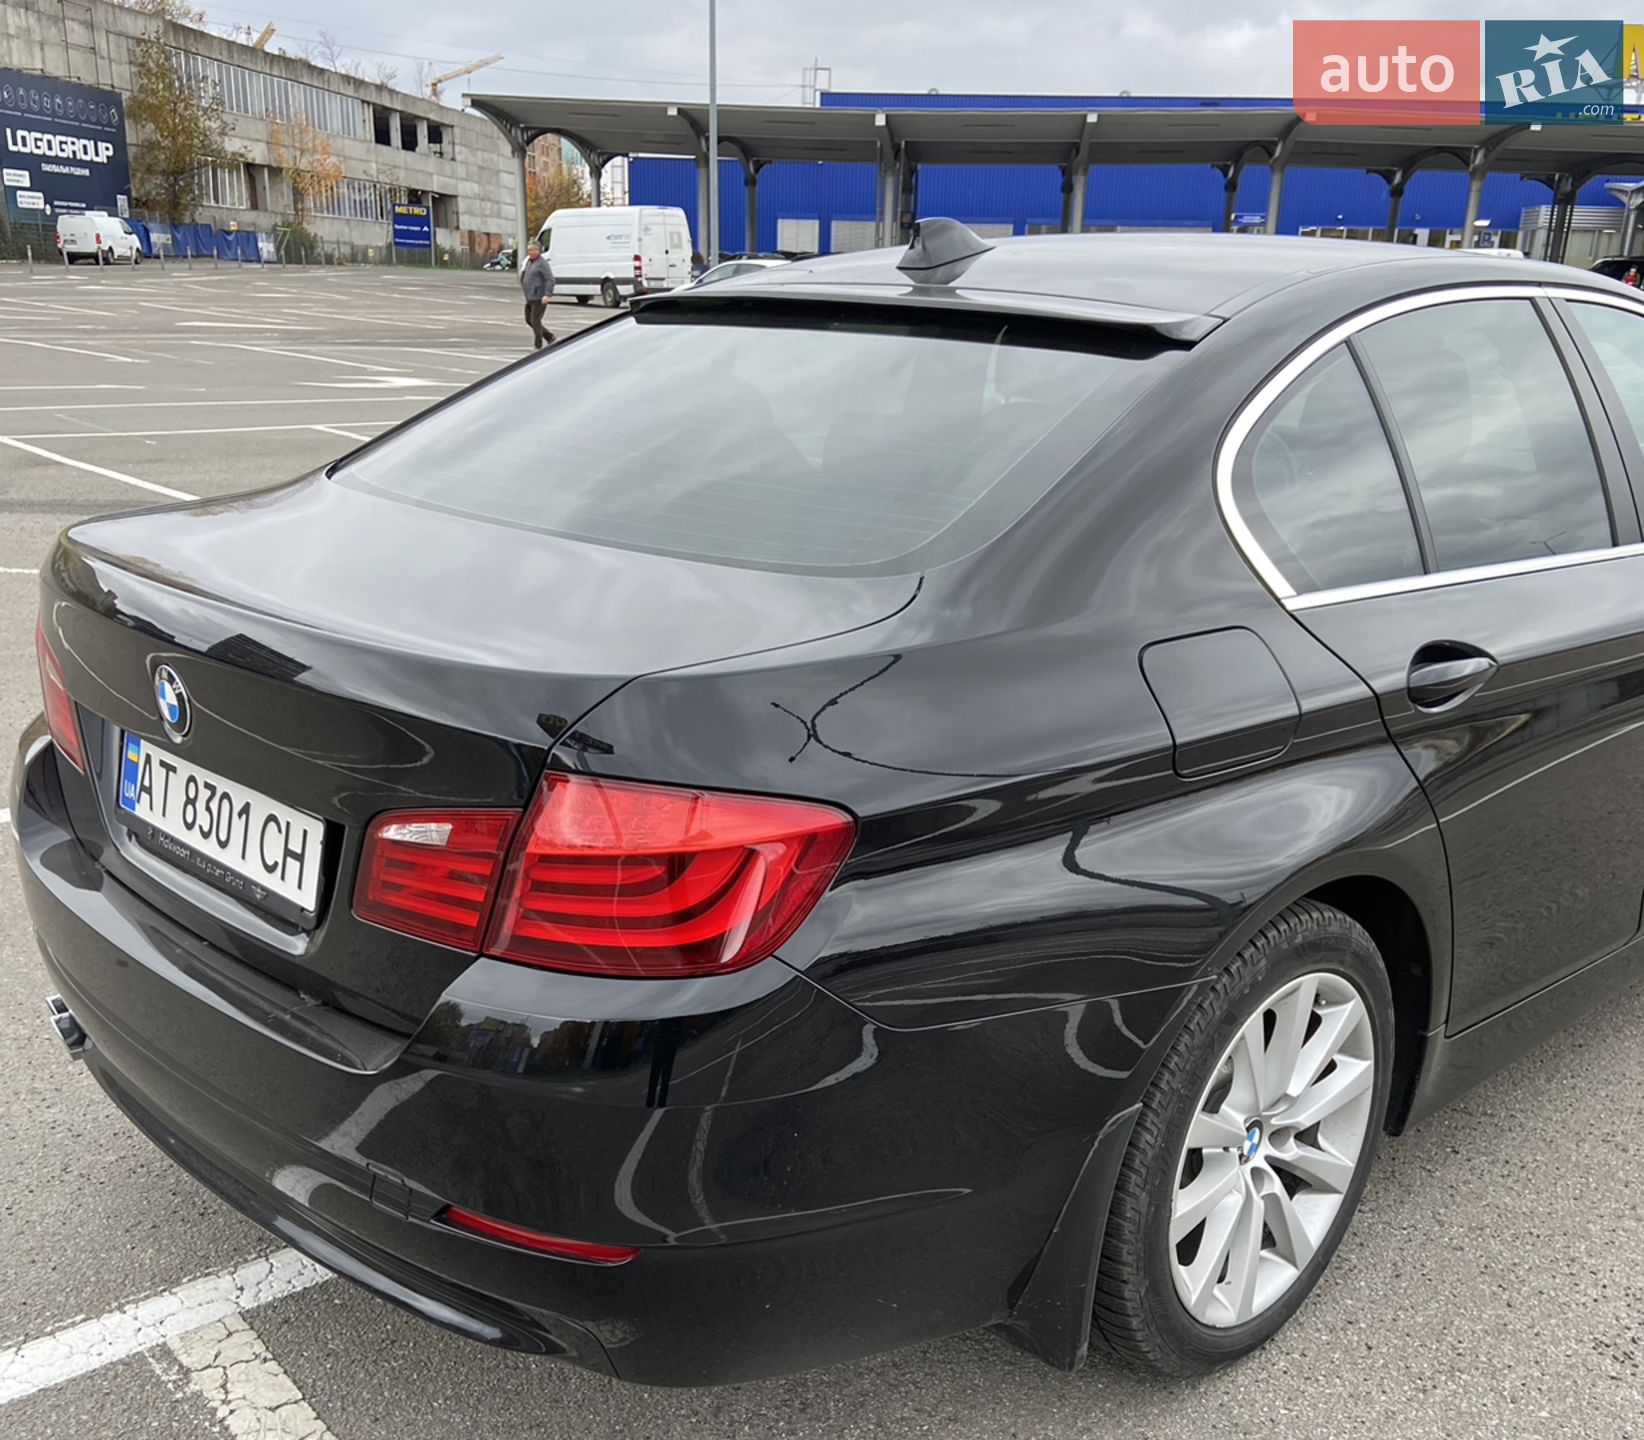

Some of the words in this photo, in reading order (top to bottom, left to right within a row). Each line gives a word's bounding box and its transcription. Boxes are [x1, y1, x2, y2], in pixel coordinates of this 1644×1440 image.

[6, 127, 114, 163] LOGOGROUP
[395, 205, 427, 216] METRO
[124, 779, 136, 800] UA
[137, 752, 177, 818] AT
[182, 774, 251, 861] 8301
[260, 813, 309, 891] CH
